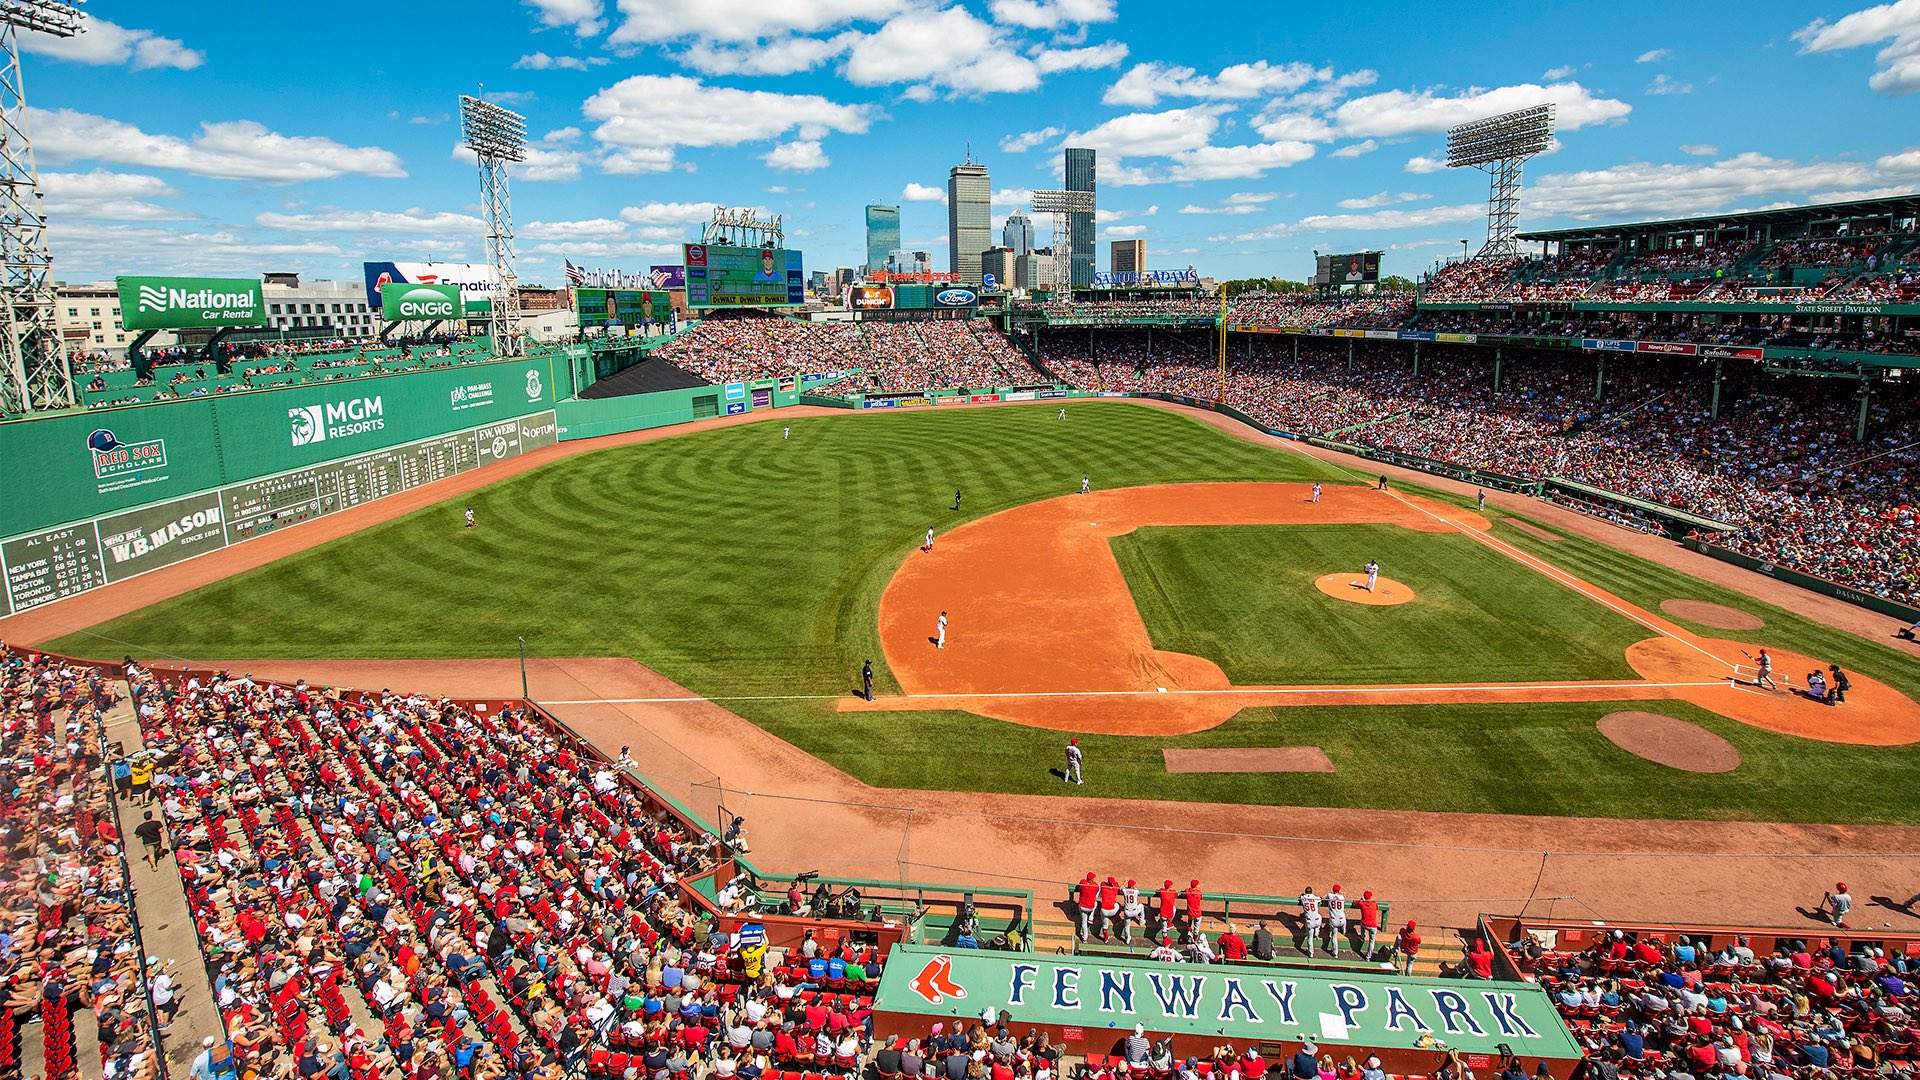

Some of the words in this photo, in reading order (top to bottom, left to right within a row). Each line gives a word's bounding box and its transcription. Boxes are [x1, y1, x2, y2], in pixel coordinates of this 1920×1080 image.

[703, 206, 737, 240] John
[577, 266, 604, 288] Bank
[605, 268, 616, 288] of
[615, 269, 653, 288] America
[1094, 271, 1141, 287] SAMUEL
[1151, 270, 1197, 283] ADAMS
[169, 288, 254, 309] National
[945, 293, 968, 303] Ford
[201, 310, 219, 319] Car
[222, 309, 253, 319] Rental
[1816, 305, 1841, 313] STREET
[1844, 305, 1882, 313] PAVILION
[468, 389, 493, 399] CHALLENGE
[326, 395, 384, 425] MGM
[329, 418, 385, 440] RESORTS
[530, 423, 555, 438] OPTUM
[98, 449, 129, 466] RED
[132, 444, 161, 460] SOX
[344, 457, 371, 467] AMERICAN
[100, 457, 162, 473] SCHOLARS
[246, 477, 285, 491] FENWAY
[292, 470, 316, 481] PARK
[241, 506, 261, 516] BOSTON
[295, 505, 307, 513] OUT
[27, 538, 42, 547] AL
[45, 529, 74, 542] EAST
[53, 545, 60, 553] W
[65, 542, 72, 550] L
[75, 538, 86, 547] GB
[102, 534, 125, 547] WHO
[125, 529, 143, 541] BUT
[180, 534, 203, 545] SINCE
[204, 528, 221, 538] 1898
[8, 564, 26, 575] NEW
[26, 558, 48, 570] YORK
[53, 554, 64, 563] 76
[66, 551, 75, 559] 41
[10, 571, 36, 583] TAMPA
[36, 567, 50, 577] BAY
[54, 563, 65, 571] 68
[66, 559, 77, 568] 50
[81, 556, 87, 564] 8
[12, 578, 45, 593] BOSTON
[56, 571, 67, 580] 62
[68, 568, 78, 576] 57
[14, 585, 52, 601] TORONTO
[57, 579, 69, 588] 49
[70, 576, 79, 584] 71
[81, 572, 92, 581] 28
[15, 592, 58, 611] BALTIMORE
[59, 588, 70, 597] 38
[71, 584, 82, 593] 78
[83, 580, 93, 589] 37
[1836, 589, 1865, 603] DASANI
[1126, 894, 1135, 904] 19
[1008, 963, 1299, 1025] FENWAY
[1328, 983, 1542, 1039] PARK
